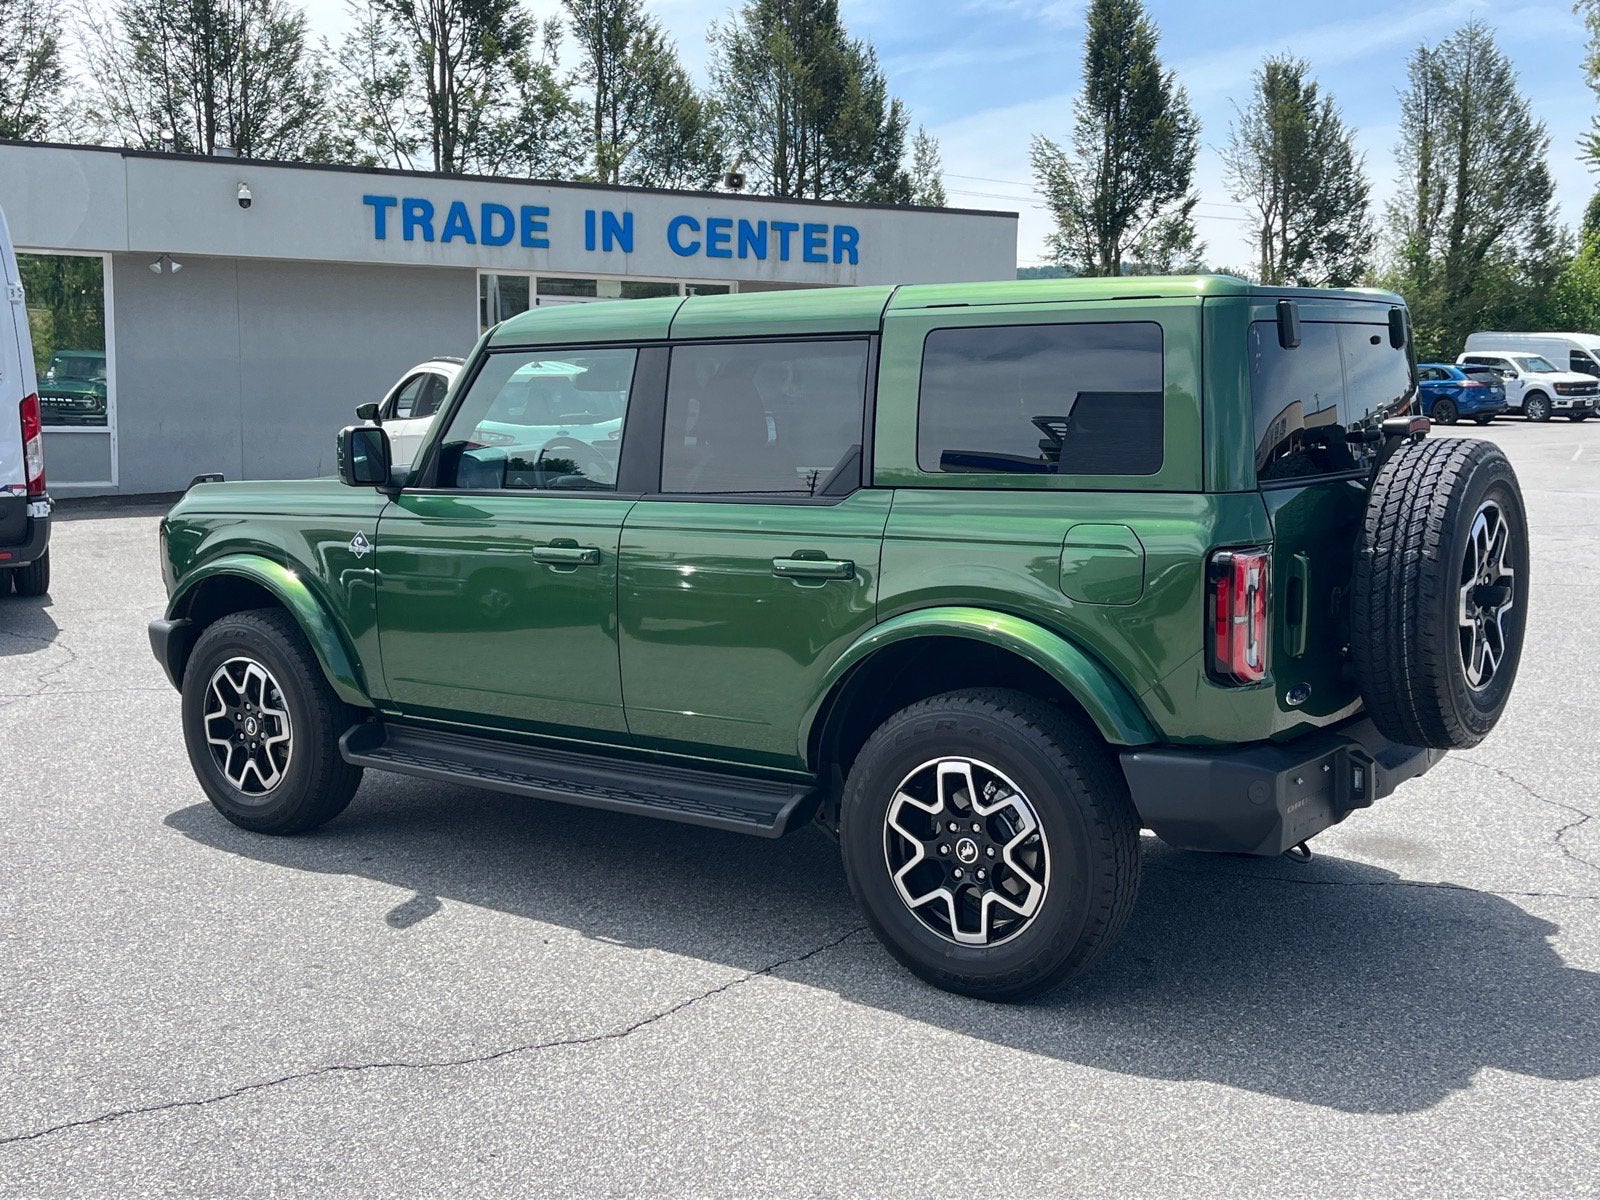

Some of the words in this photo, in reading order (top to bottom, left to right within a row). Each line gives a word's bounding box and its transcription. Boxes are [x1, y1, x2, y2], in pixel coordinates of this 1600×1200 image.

[363, 195, 550, 249] TRADE
[584, 209, 634, 253] IN
[667, 215, 860, 265] CENTER
